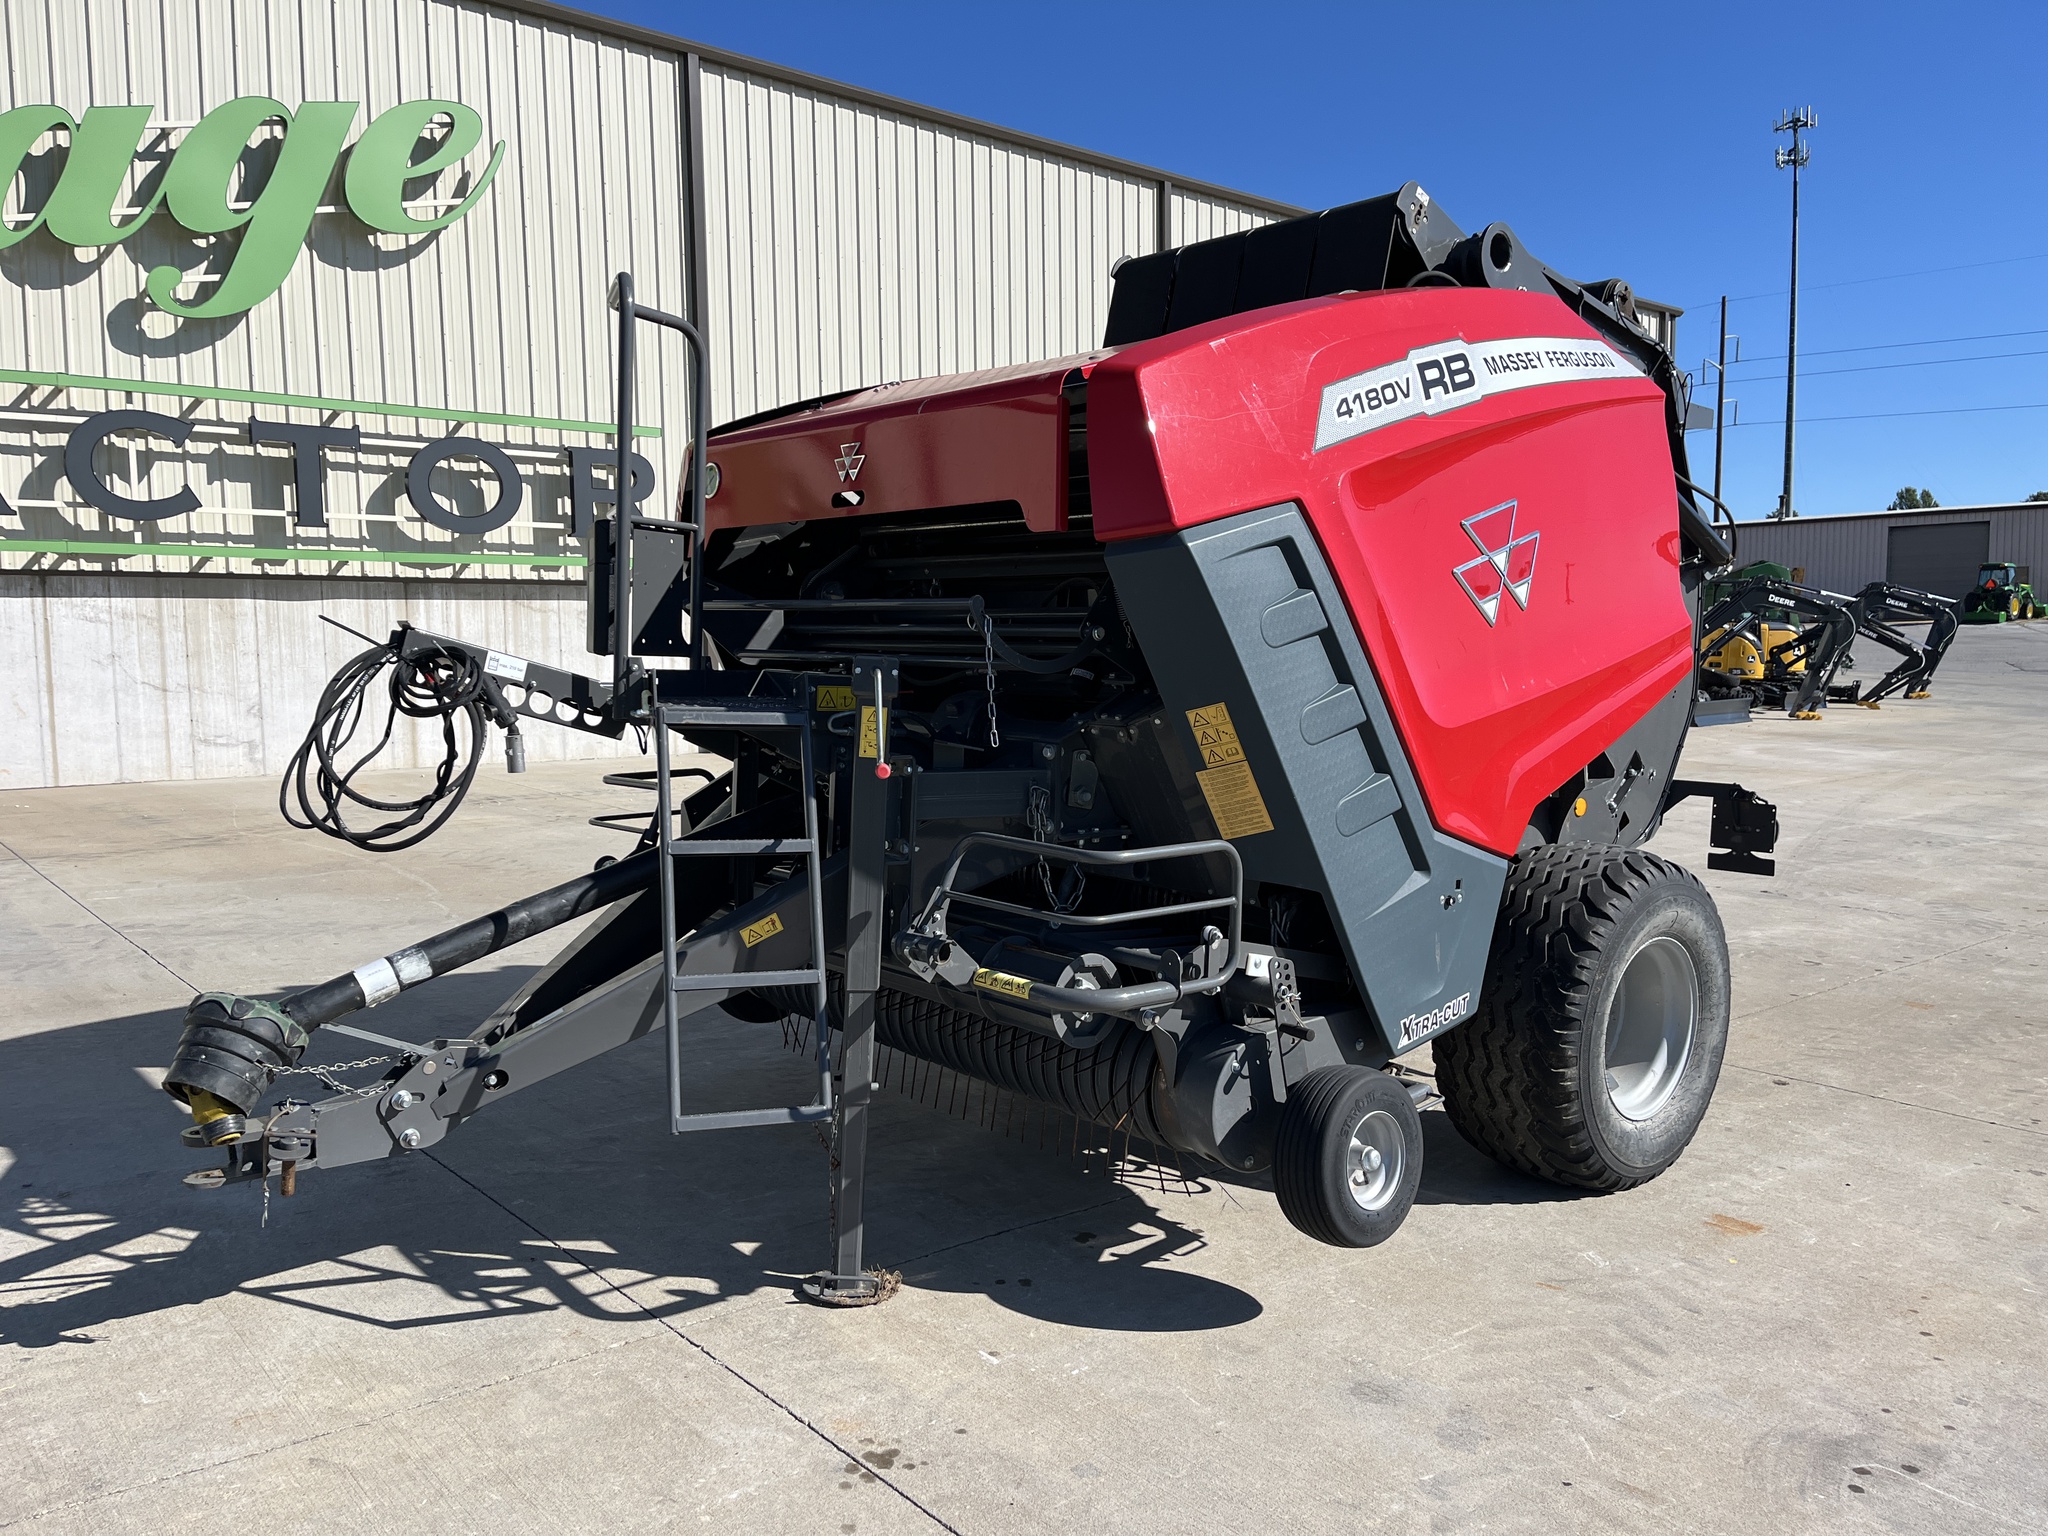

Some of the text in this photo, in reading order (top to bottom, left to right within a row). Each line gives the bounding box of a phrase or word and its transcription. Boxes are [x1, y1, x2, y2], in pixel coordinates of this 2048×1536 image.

[1336, 351, 1616, 419] 4180V RB MASSEY FERGUSON
[0, 409, 656, 539] CTOR
[1768, 594, 1796, 608] DEERE
[1885, 597, 1909, 609] DEERE
[1399, 993, 1469, 1045] XTRA-CUT
